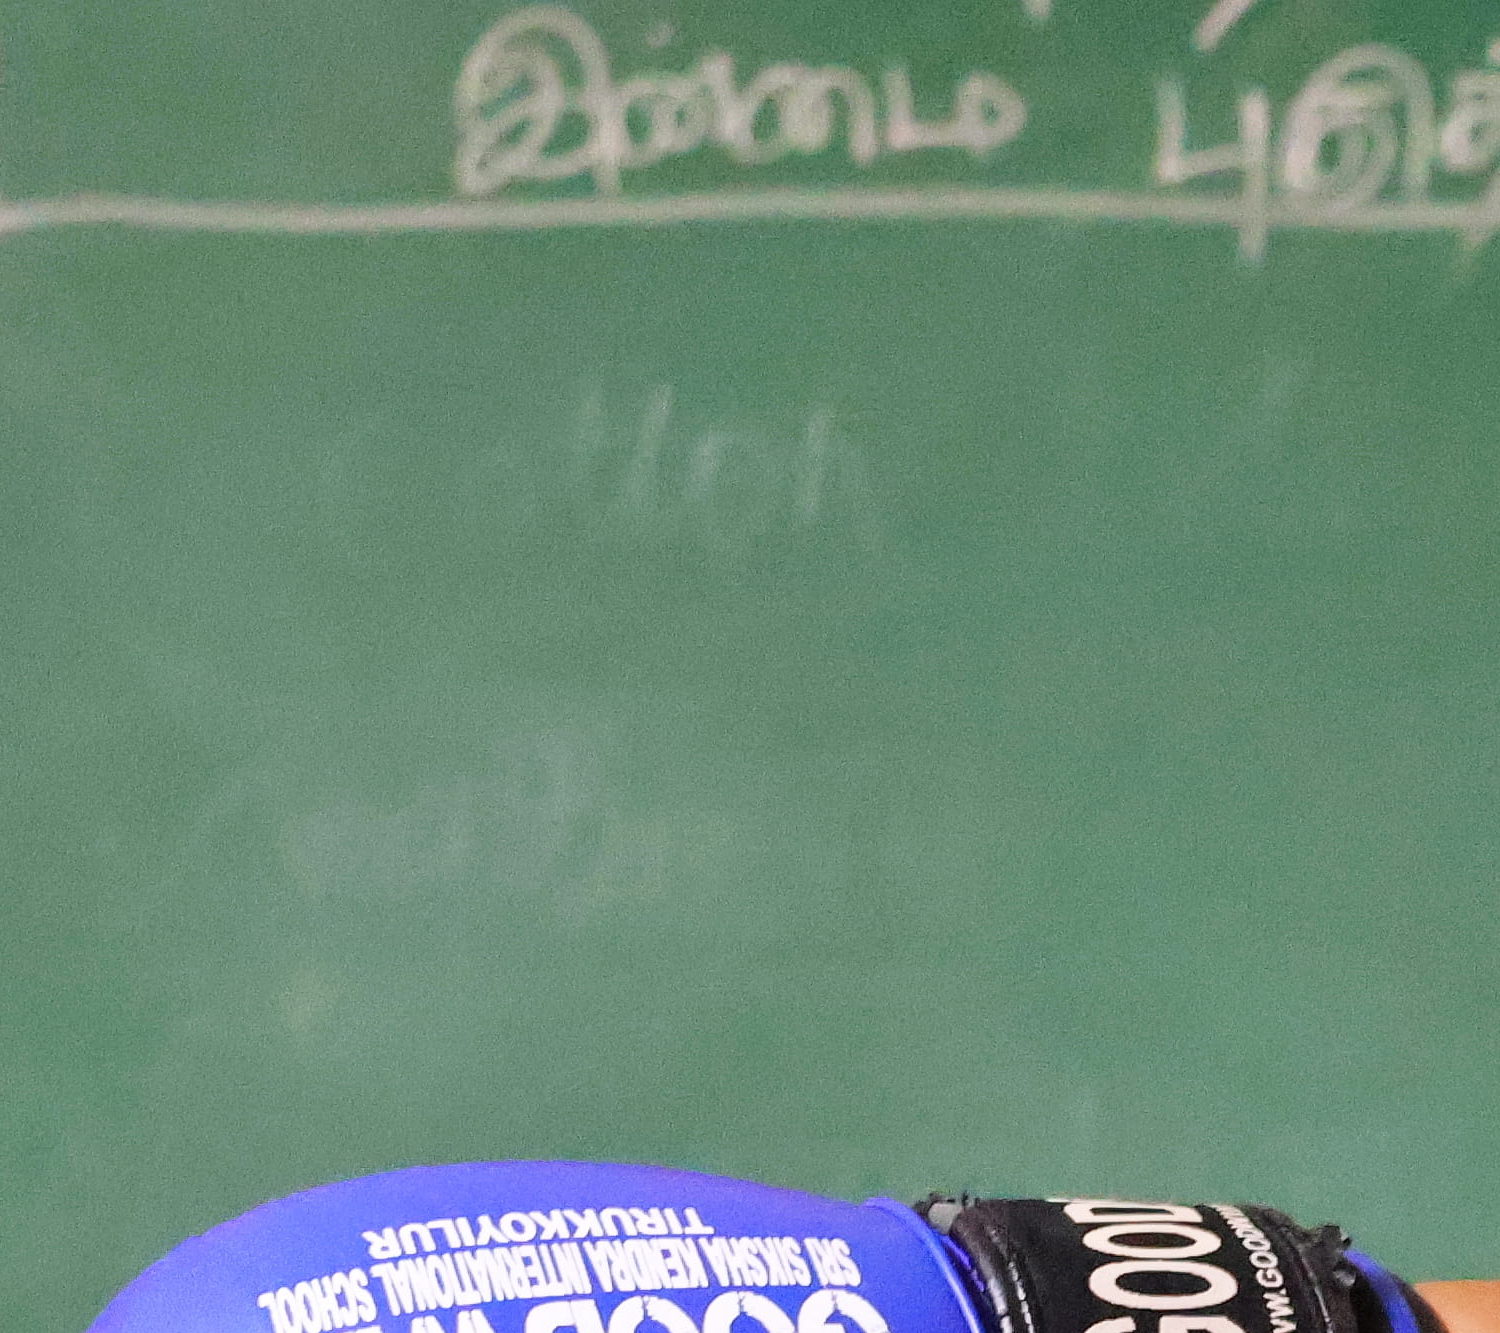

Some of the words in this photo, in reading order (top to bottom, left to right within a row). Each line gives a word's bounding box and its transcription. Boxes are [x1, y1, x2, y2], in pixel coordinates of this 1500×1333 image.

[362, 1206, 715, 1260] TIRUKKOYILUR
[370, 1242, 597, 1318] INTERNATIONAL
[587, 1237, 709, 1292] KENDRA
[704, 1235, 807, 1288] SIKSHA
[805, 1236, 862, 1287] SRI
